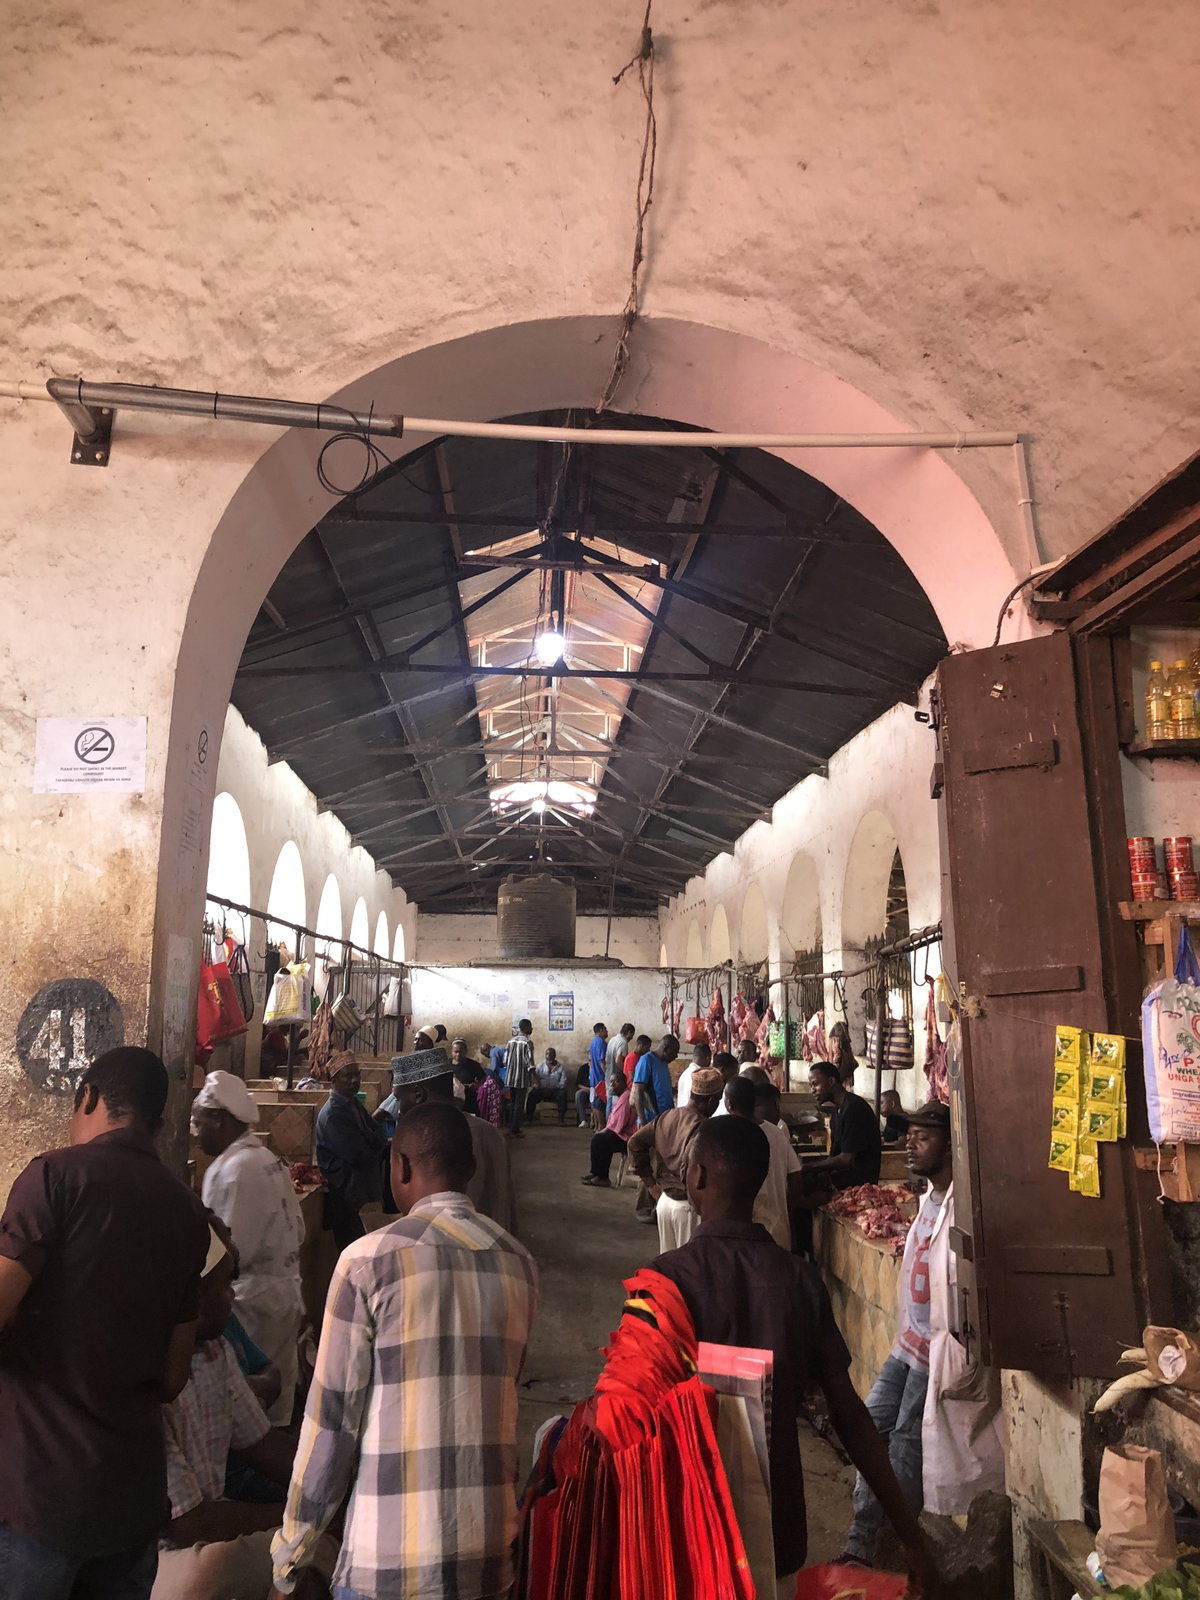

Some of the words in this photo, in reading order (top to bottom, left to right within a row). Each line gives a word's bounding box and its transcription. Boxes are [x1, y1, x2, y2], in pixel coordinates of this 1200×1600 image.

[28, 1007, 91, 1070] 41
[1176, 1068, 1200, 1077] WHE
[1168, 1073, 1194, 1083] UNGA
